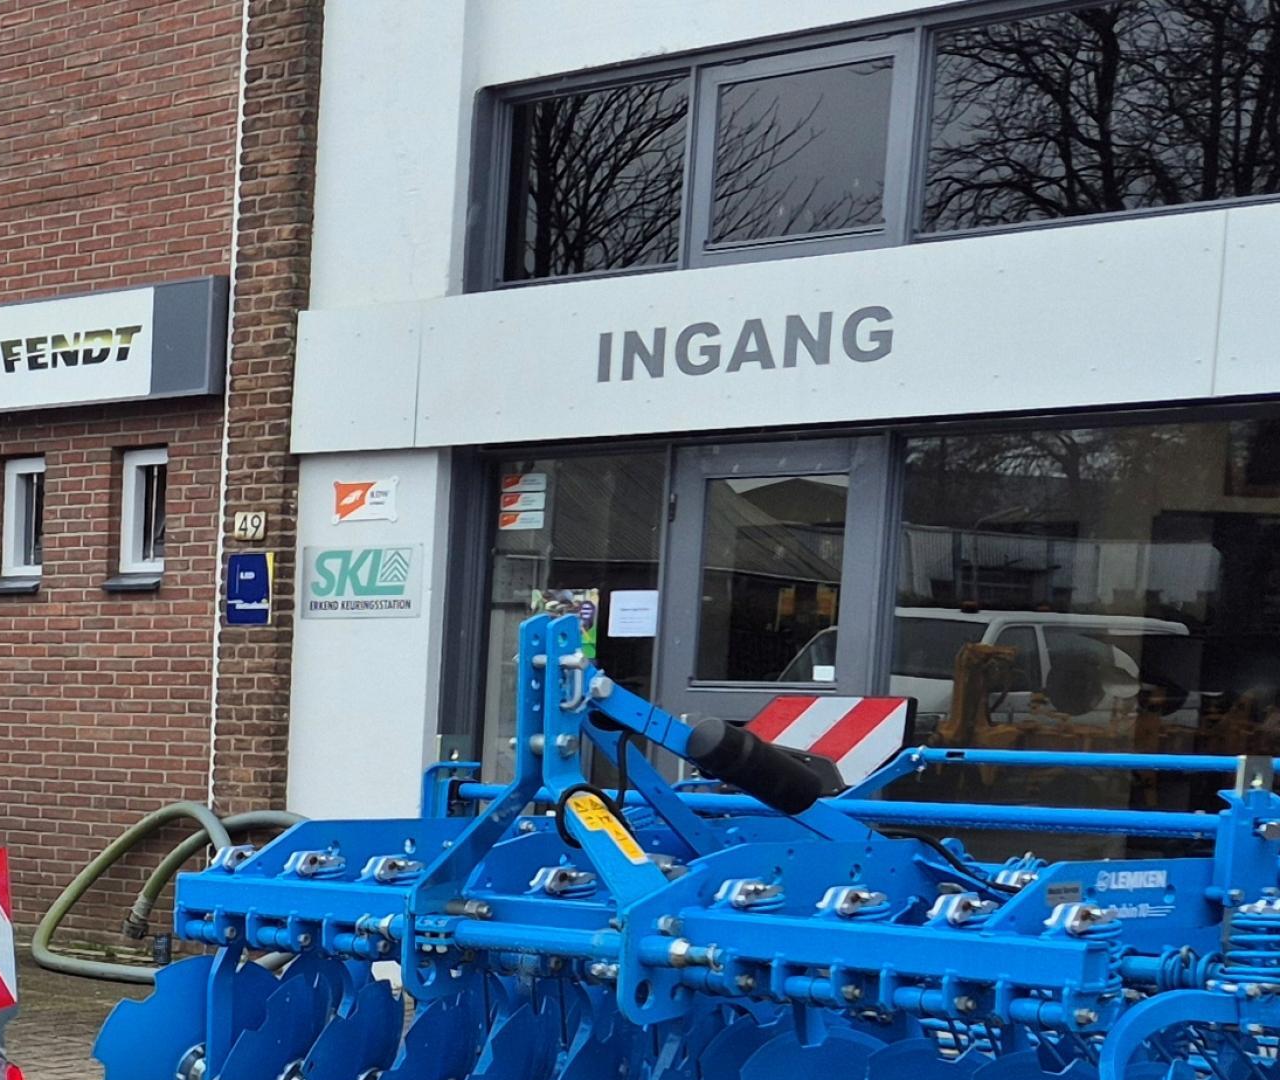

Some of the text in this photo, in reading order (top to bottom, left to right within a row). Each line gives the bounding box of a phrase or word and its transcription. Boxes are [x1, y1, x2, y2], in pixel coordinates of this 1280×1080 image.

[0, 325, 143, 373] FENDT
[597, 305, 894, 382] INGANG
[238, 514, 262, 538] 49
[310, 548, 406, 597] SKL
[1109, 870, 1168, 891] LEMKEN
